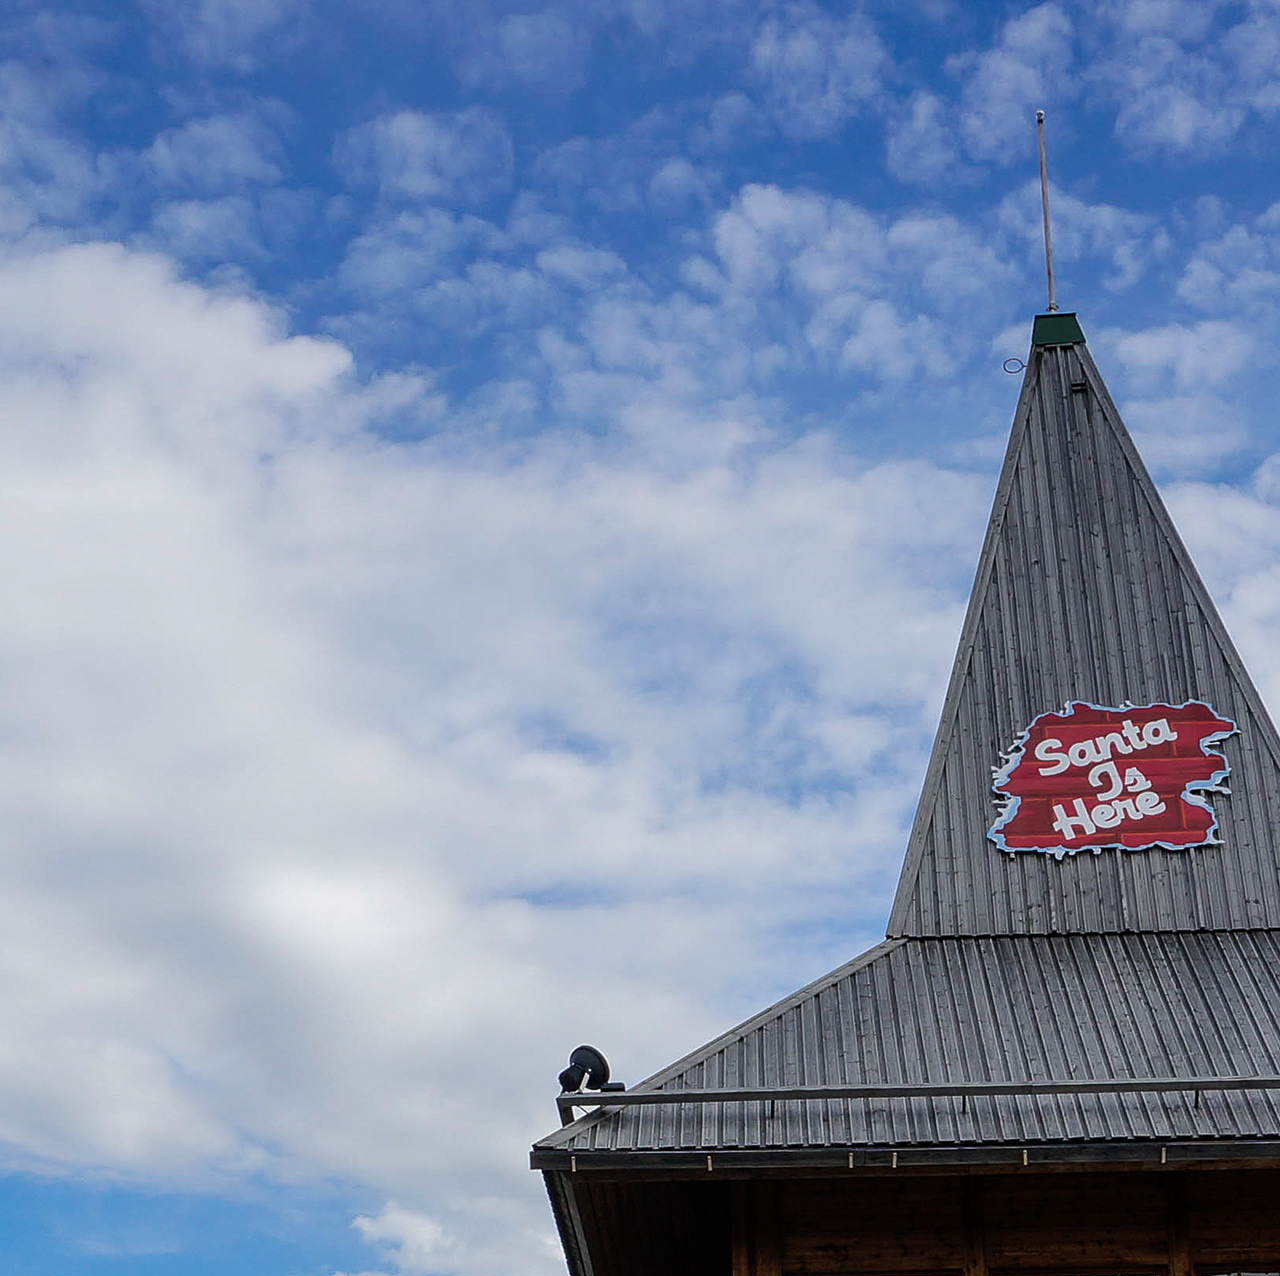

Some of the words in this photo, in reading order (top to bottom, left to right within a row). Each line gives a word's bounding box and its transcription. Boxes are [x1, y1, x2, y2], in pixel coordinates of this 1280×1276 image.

[1034, 718, 1178, 777] Santa
[1088, 761, 1152, 802] Is
[1052, 791, 1167, 841] Here
